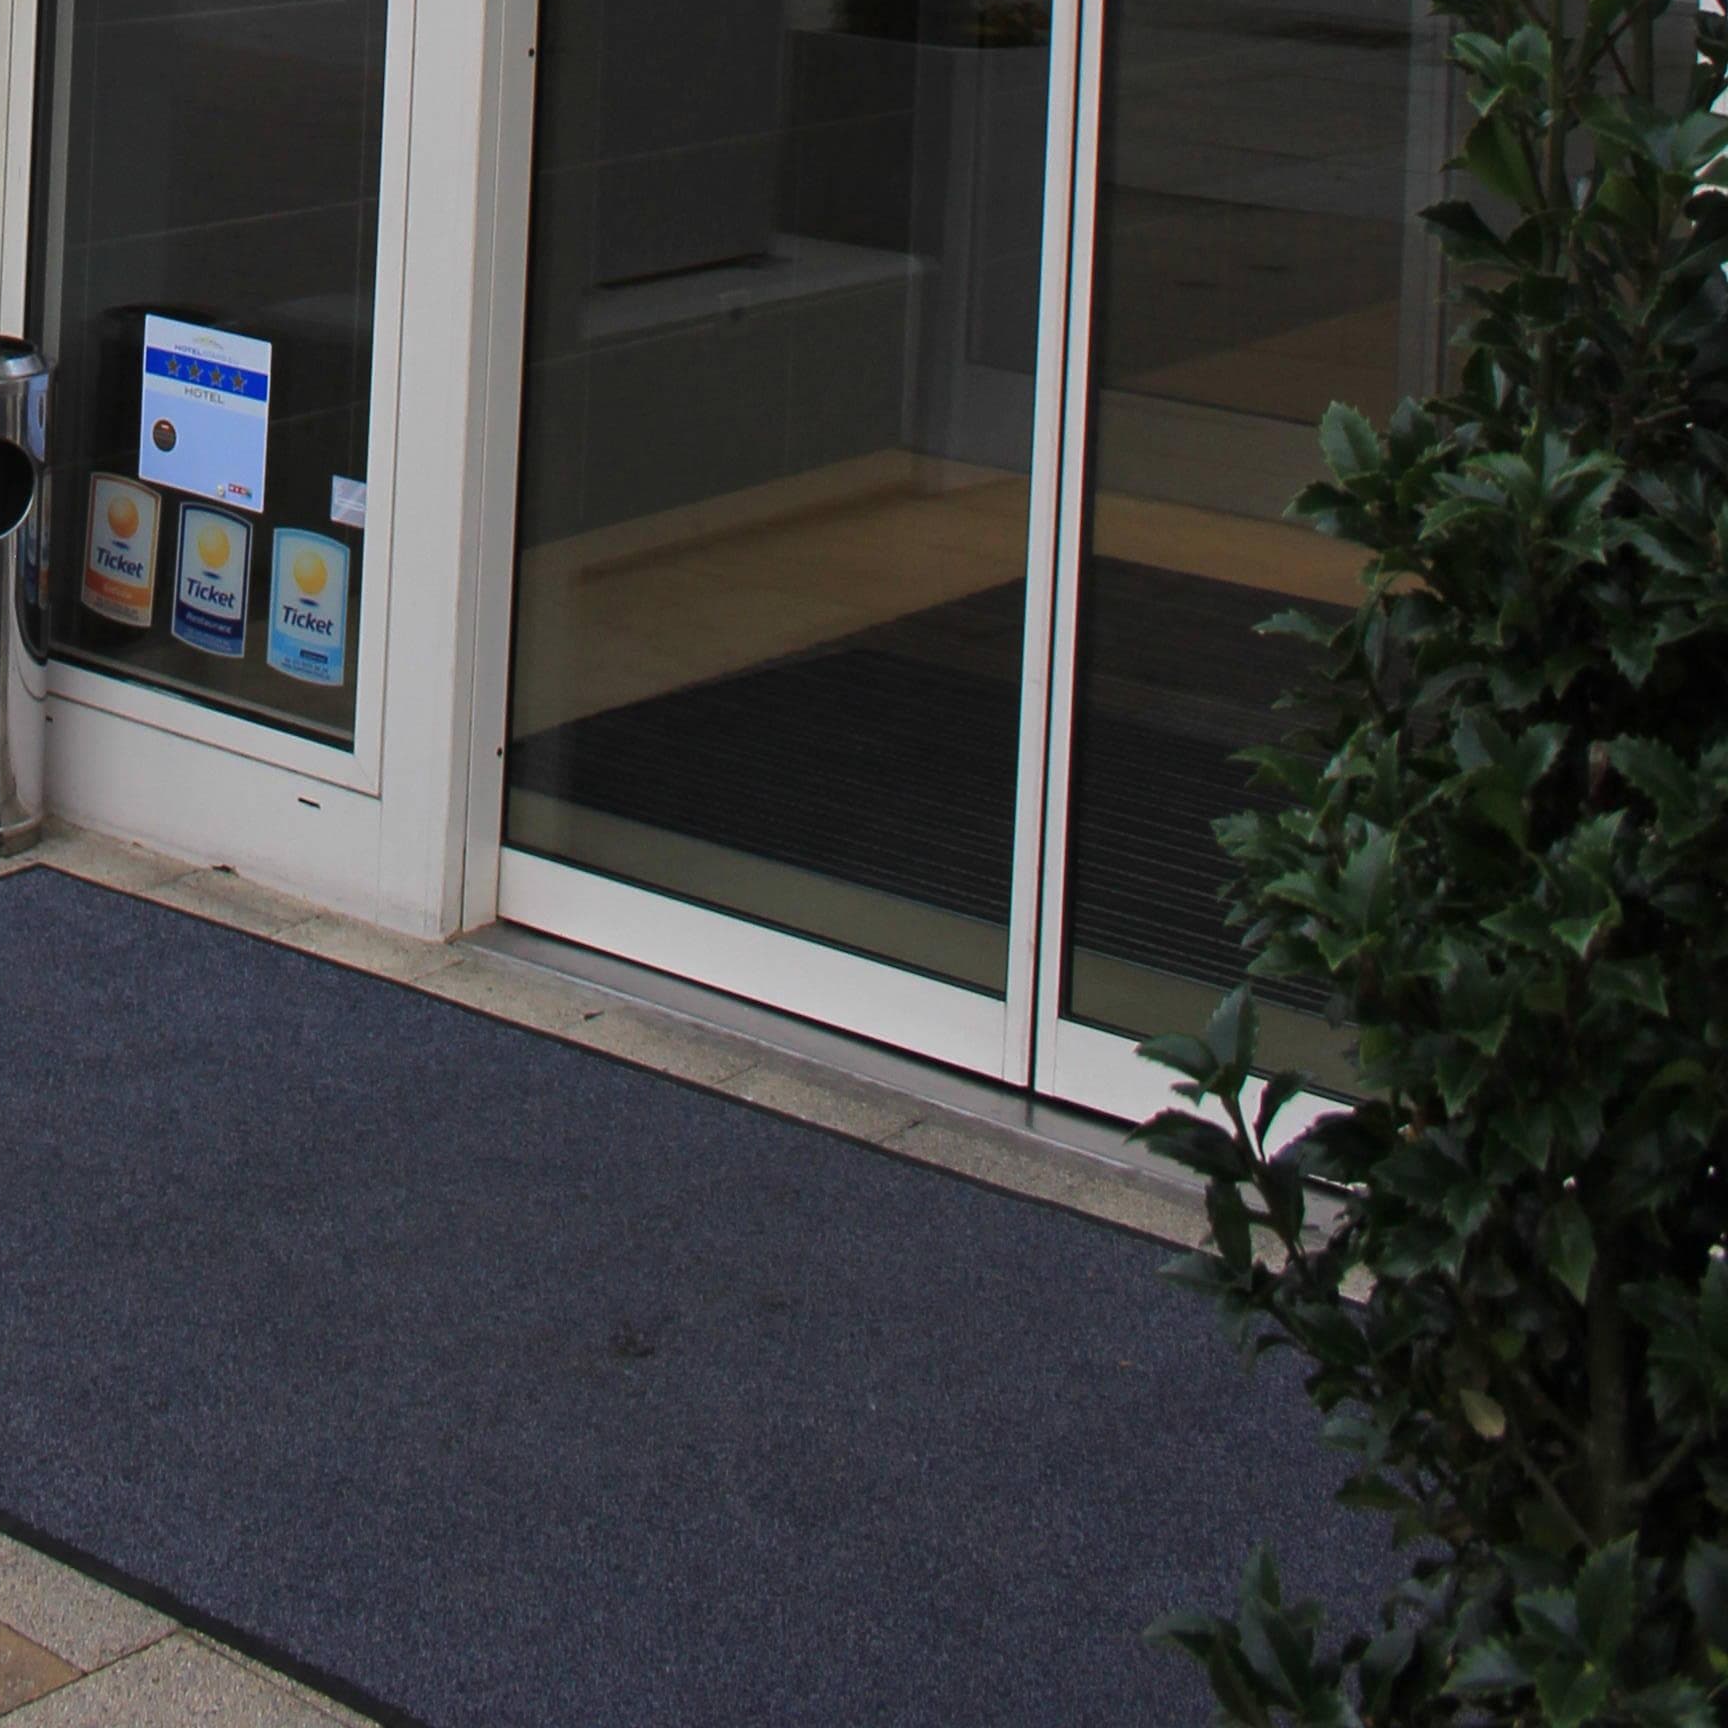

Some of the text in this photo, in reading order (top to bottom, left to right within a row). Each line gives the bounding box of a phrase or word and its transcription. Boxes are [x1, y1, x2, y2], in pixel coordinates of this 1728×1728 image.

[184, 386, 224, 404] HOTEL
[96, 545, 145, 580] Ticket
[186, 577, 236, 609] Ticket
[282, 604, 335, 636] Ticket
